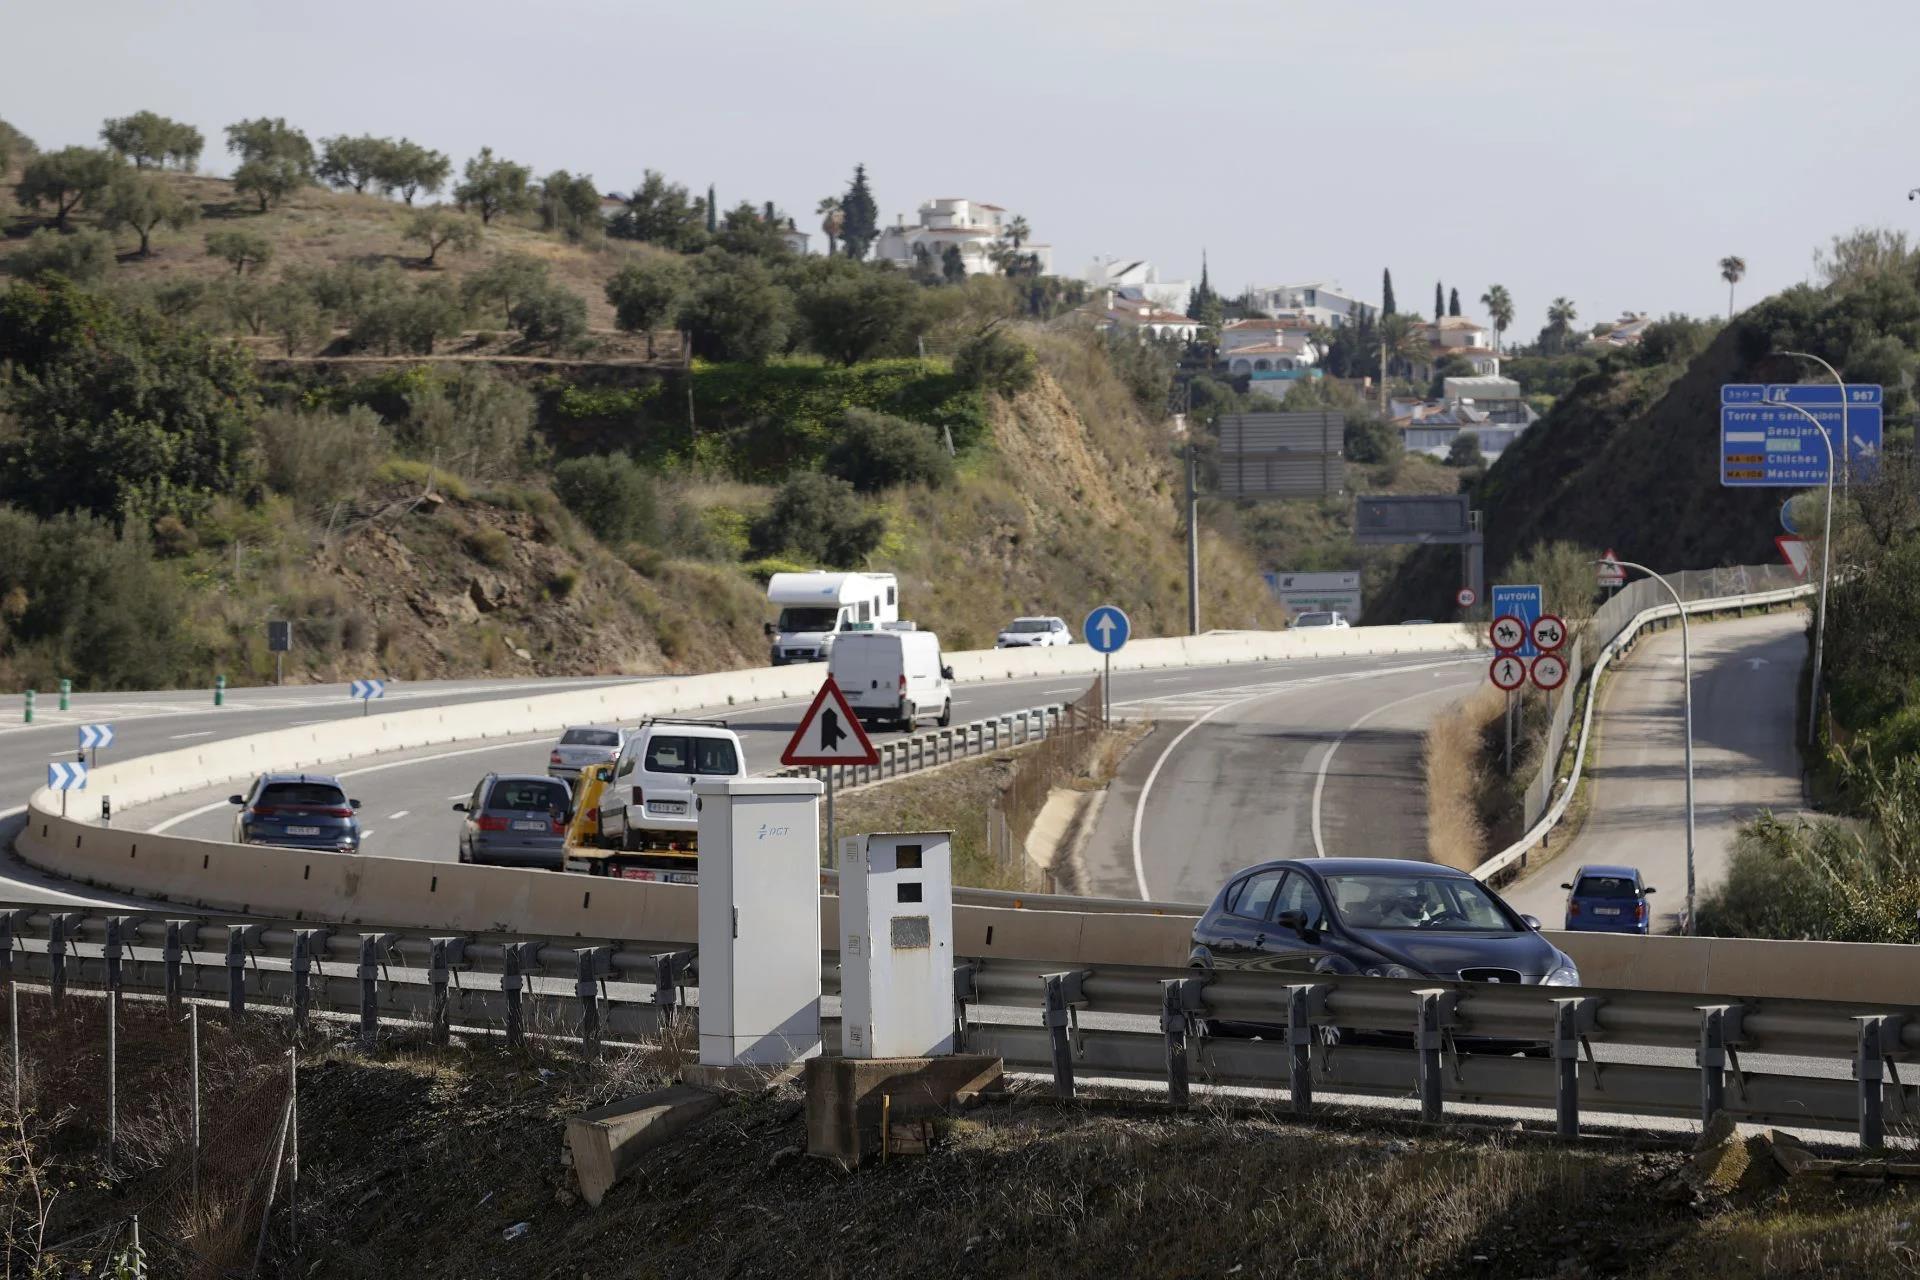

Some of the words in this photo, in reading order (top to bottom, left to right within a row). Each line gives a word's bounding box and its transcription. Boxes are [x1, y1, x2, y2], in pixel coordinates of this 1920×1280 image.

[1728, 411, 1757, 421] Torre
[1761, 411, 1775, 420] de
[1767, 454, 1818, 464] Chilches
[1497, 590, 1537, 601] AUTOVÍA
